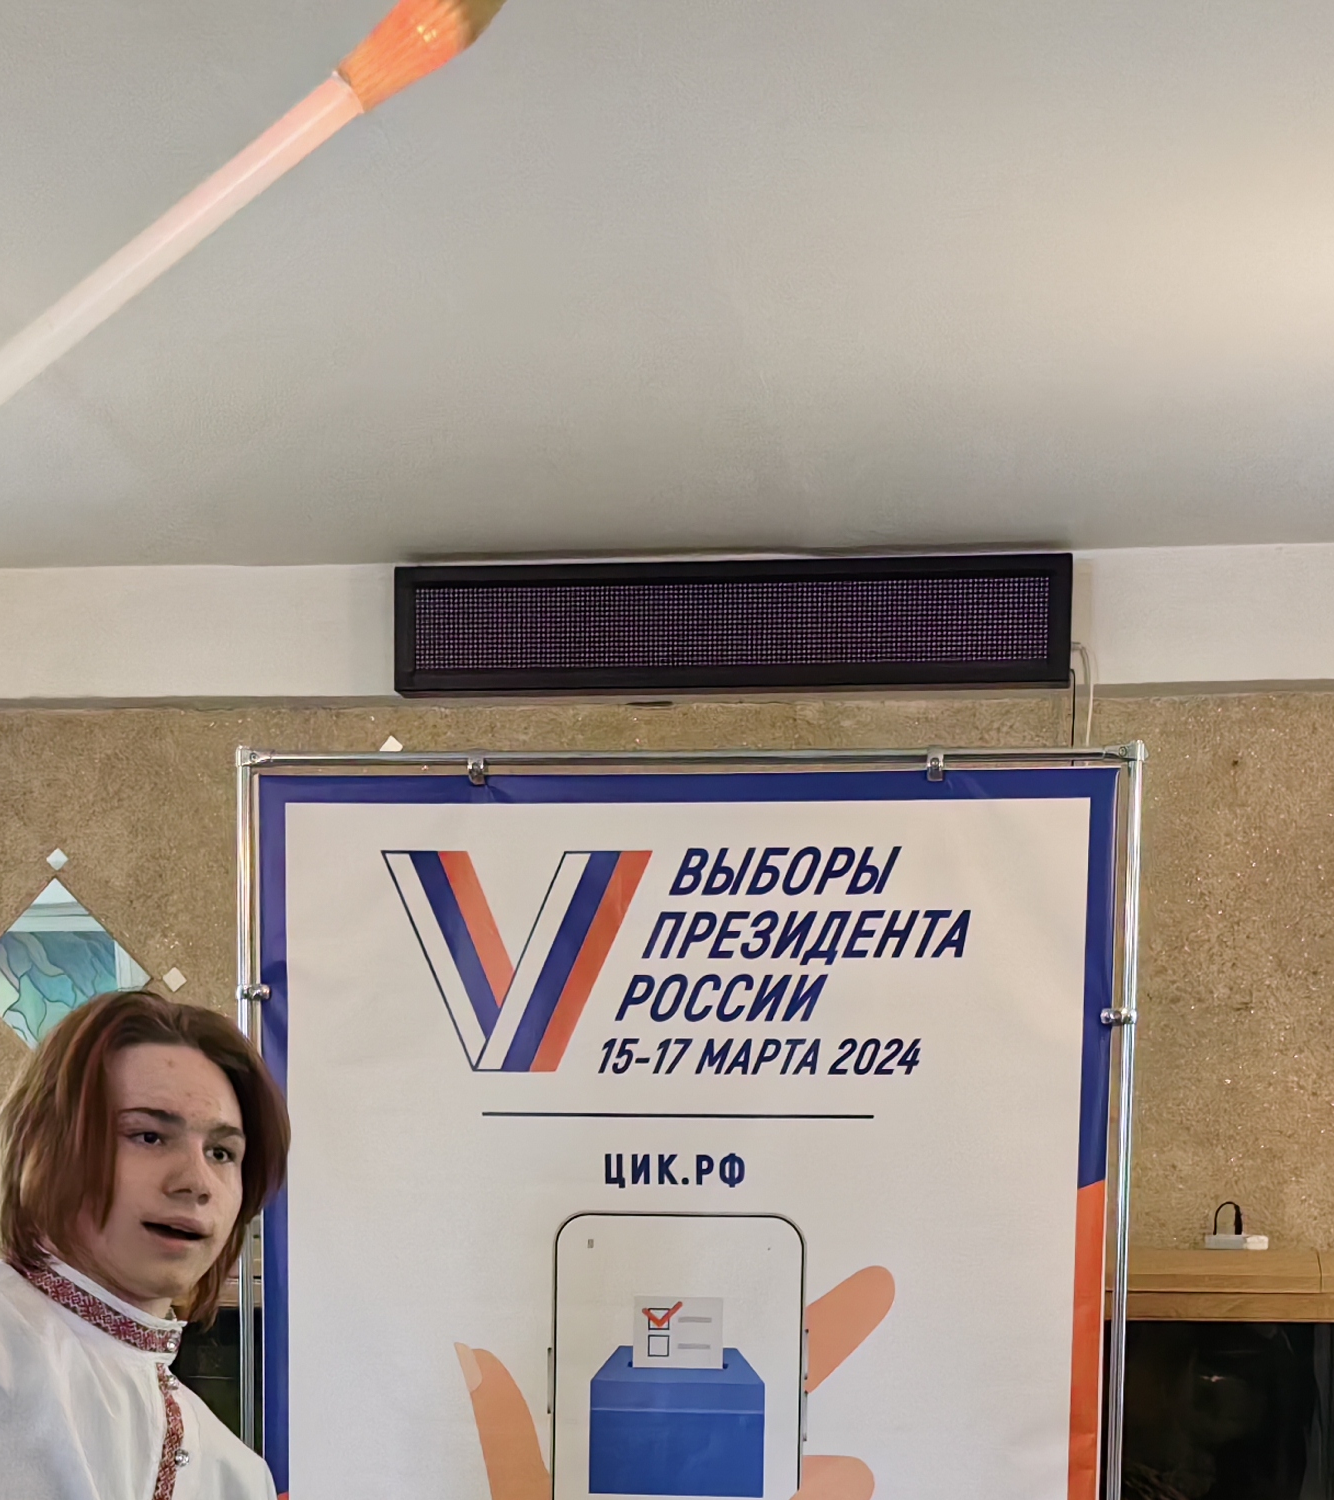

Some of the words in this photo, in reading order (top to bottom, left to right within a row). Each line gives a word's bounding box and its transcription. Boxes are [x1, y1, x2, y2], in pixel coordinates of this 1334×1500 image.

[668, 845, 903, 896] ВЫБОРЫ
[641, 909, 972, 966] ПРЕЗИДЕНТА
[614, 973, 829, 1024] РОССИИ
[597, 1037, 690, 1076] 15-17
[694, 1037, 821, 1077] МАРТА
[827, 1037, 922, 1077] 2024
[603, 1152, 746, 1190] ЦИК.РФ
